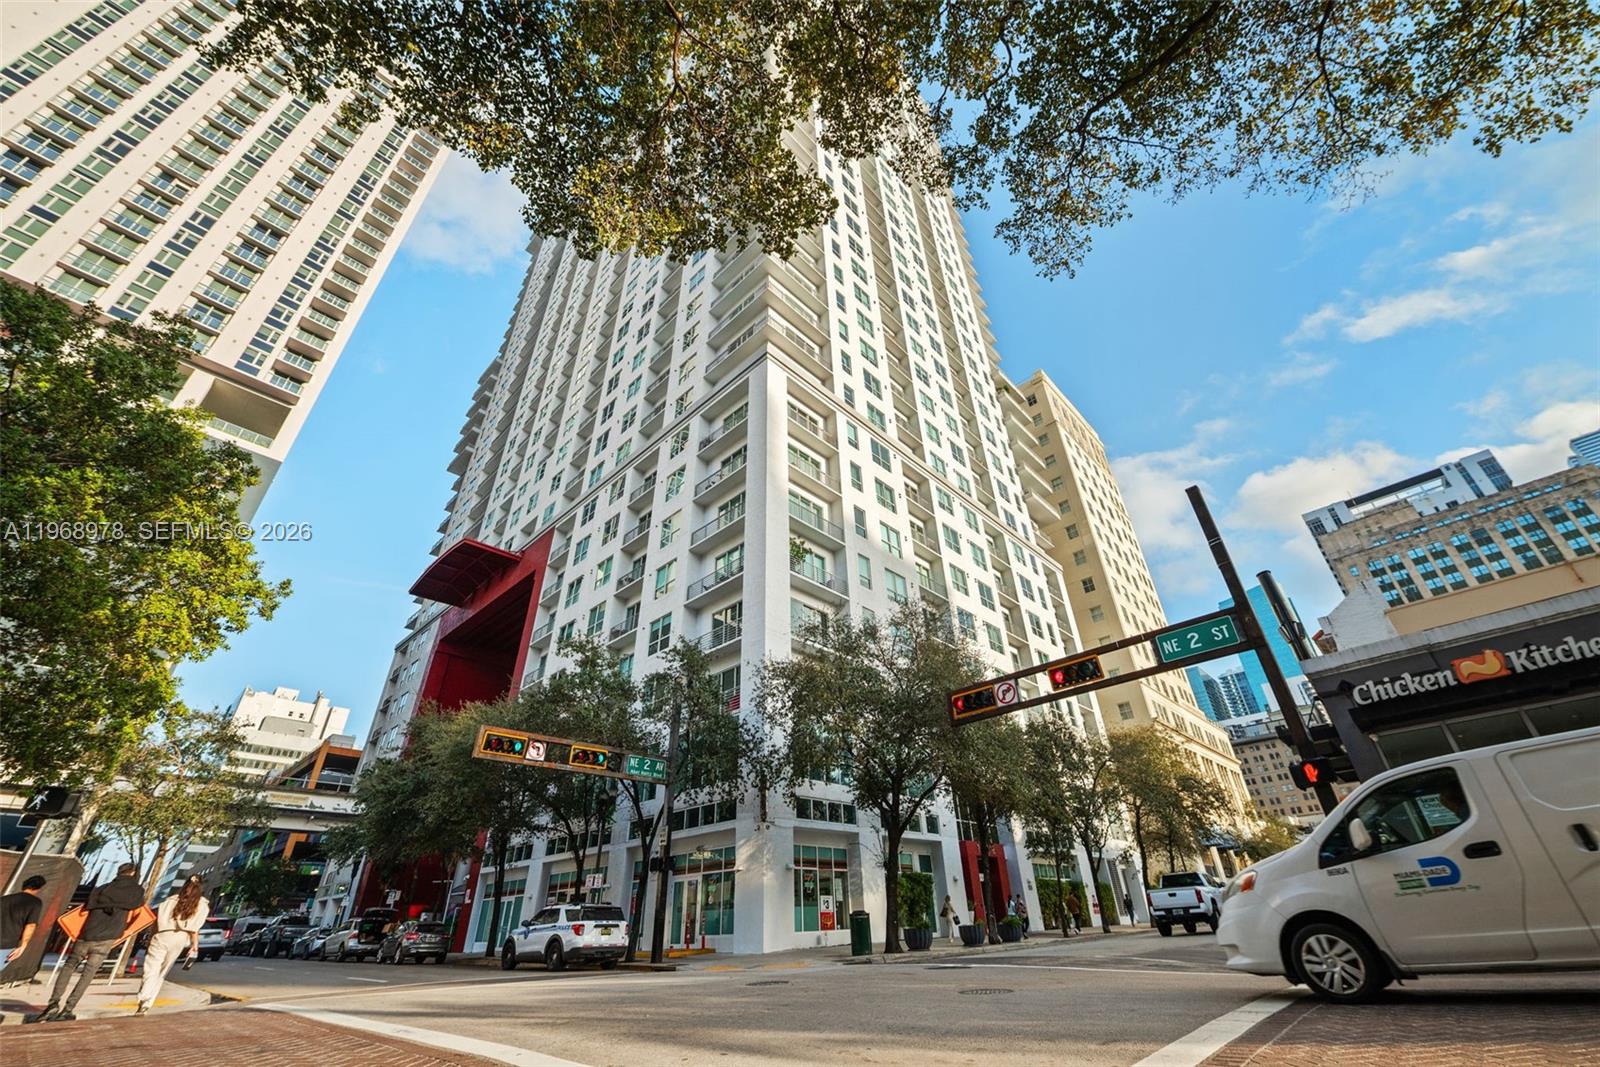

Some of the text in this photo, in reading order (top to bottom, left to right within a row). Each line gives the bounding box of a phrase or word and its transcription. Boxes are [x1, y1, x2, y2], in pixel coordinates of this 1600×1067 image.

[1163, 625, 1229, 654] NE 2 ST
[1352, 669, 1457, 705] Chicken
[630, 758, 639, 767] NE
[643, 760, 651, 769] 2
